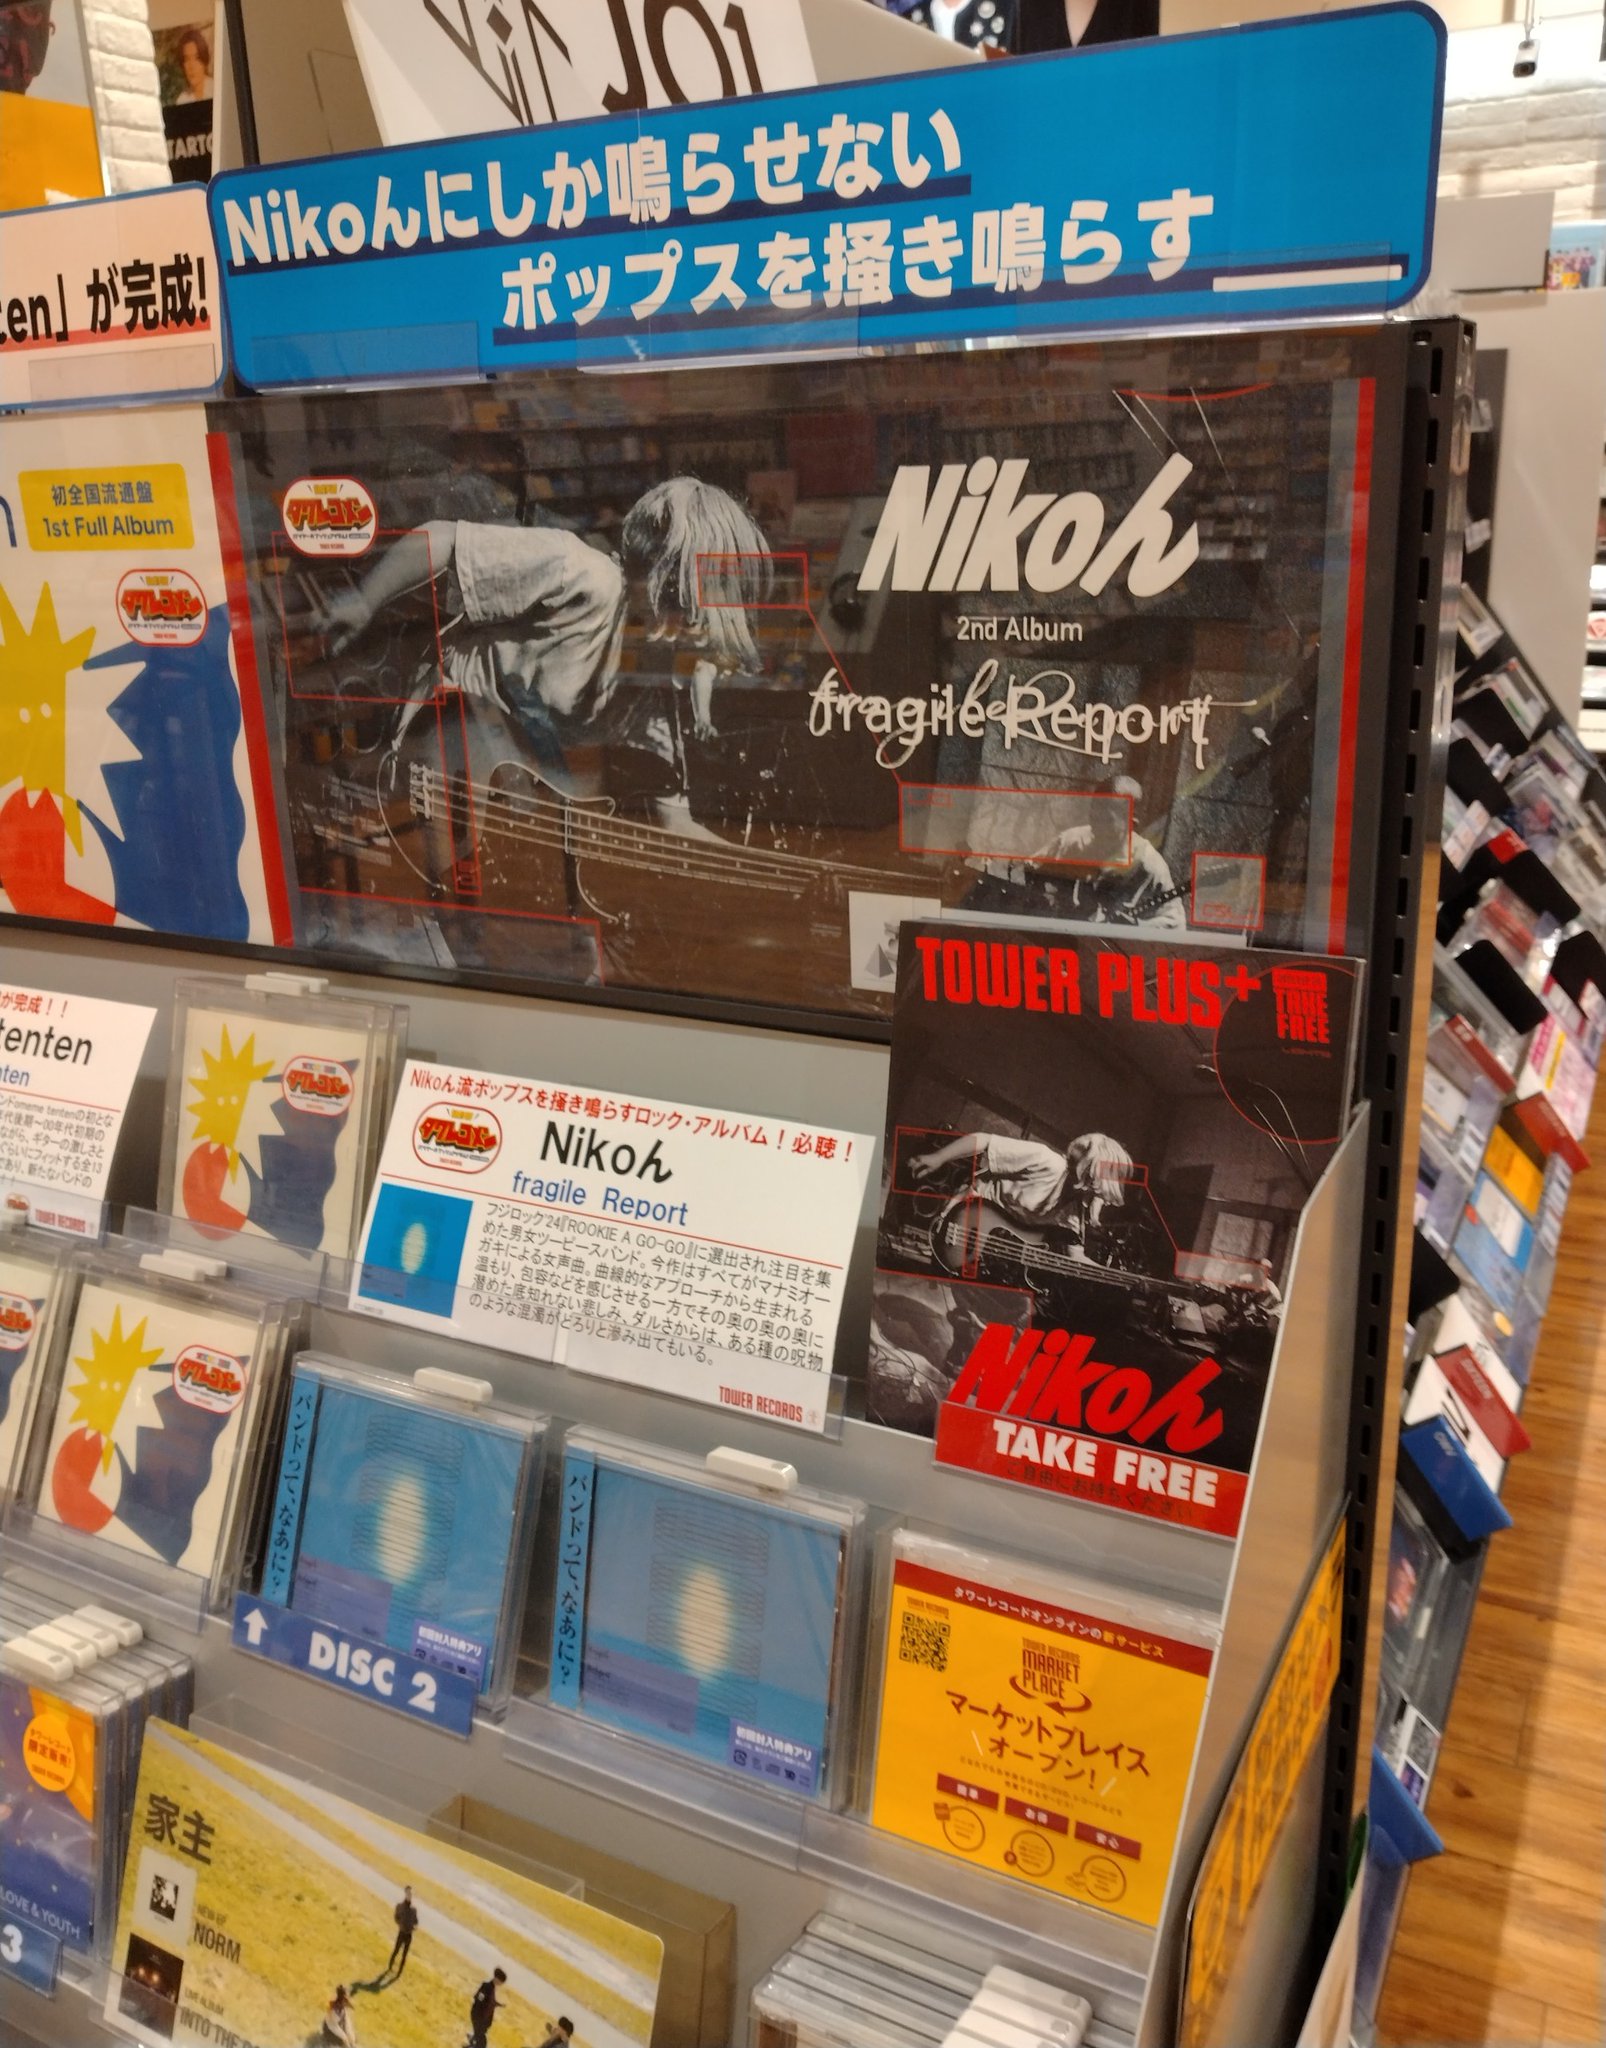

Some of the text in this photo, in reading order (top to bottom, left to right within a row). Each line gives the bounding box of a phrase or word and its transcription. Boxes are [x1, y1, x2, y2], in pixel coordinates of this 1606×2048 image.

[222, 108, 962, 268] Nikoんにしか鳴らせない
[51, 481, 154, 507] 初全国流通盤
[43, 515, 174, 538] 1st Full Album
[957, 616, 1083, 642] 2nd Album
[915, 936, 1261, 1029] TOWER PLUS+
[1277, 1012, 1330, 1044] FREE
[538, 1120, 674, 1184] Nikoん
[511, 1171, 689, 1227] fragile Report
[622, 1230, 632, 1243] A
[719, 1385, 803, 1423] TOWER RECORDS
[992, 1418, 1219, 1508] TAKE FREE
[308, 1630, 396, 1697] DISC
[407, 1671, 438, 1714] 2
[1022, 1648, 1081, 1684] MARKET
[1023, 1669, 1066, 1700] PLACE
[945, 1690, 1151, 1778] マーケットプレイス
[988, 1737, 1096, 1790] オープン!
[143, 1793, 216, 1866] 家主
[0, 1923, 23, 1964] 3
[41, 1907, 80, 1940] YOUTH
[194, 1922, 242, 1966] NORM
[180, 2006, 211, 2038] INTO
